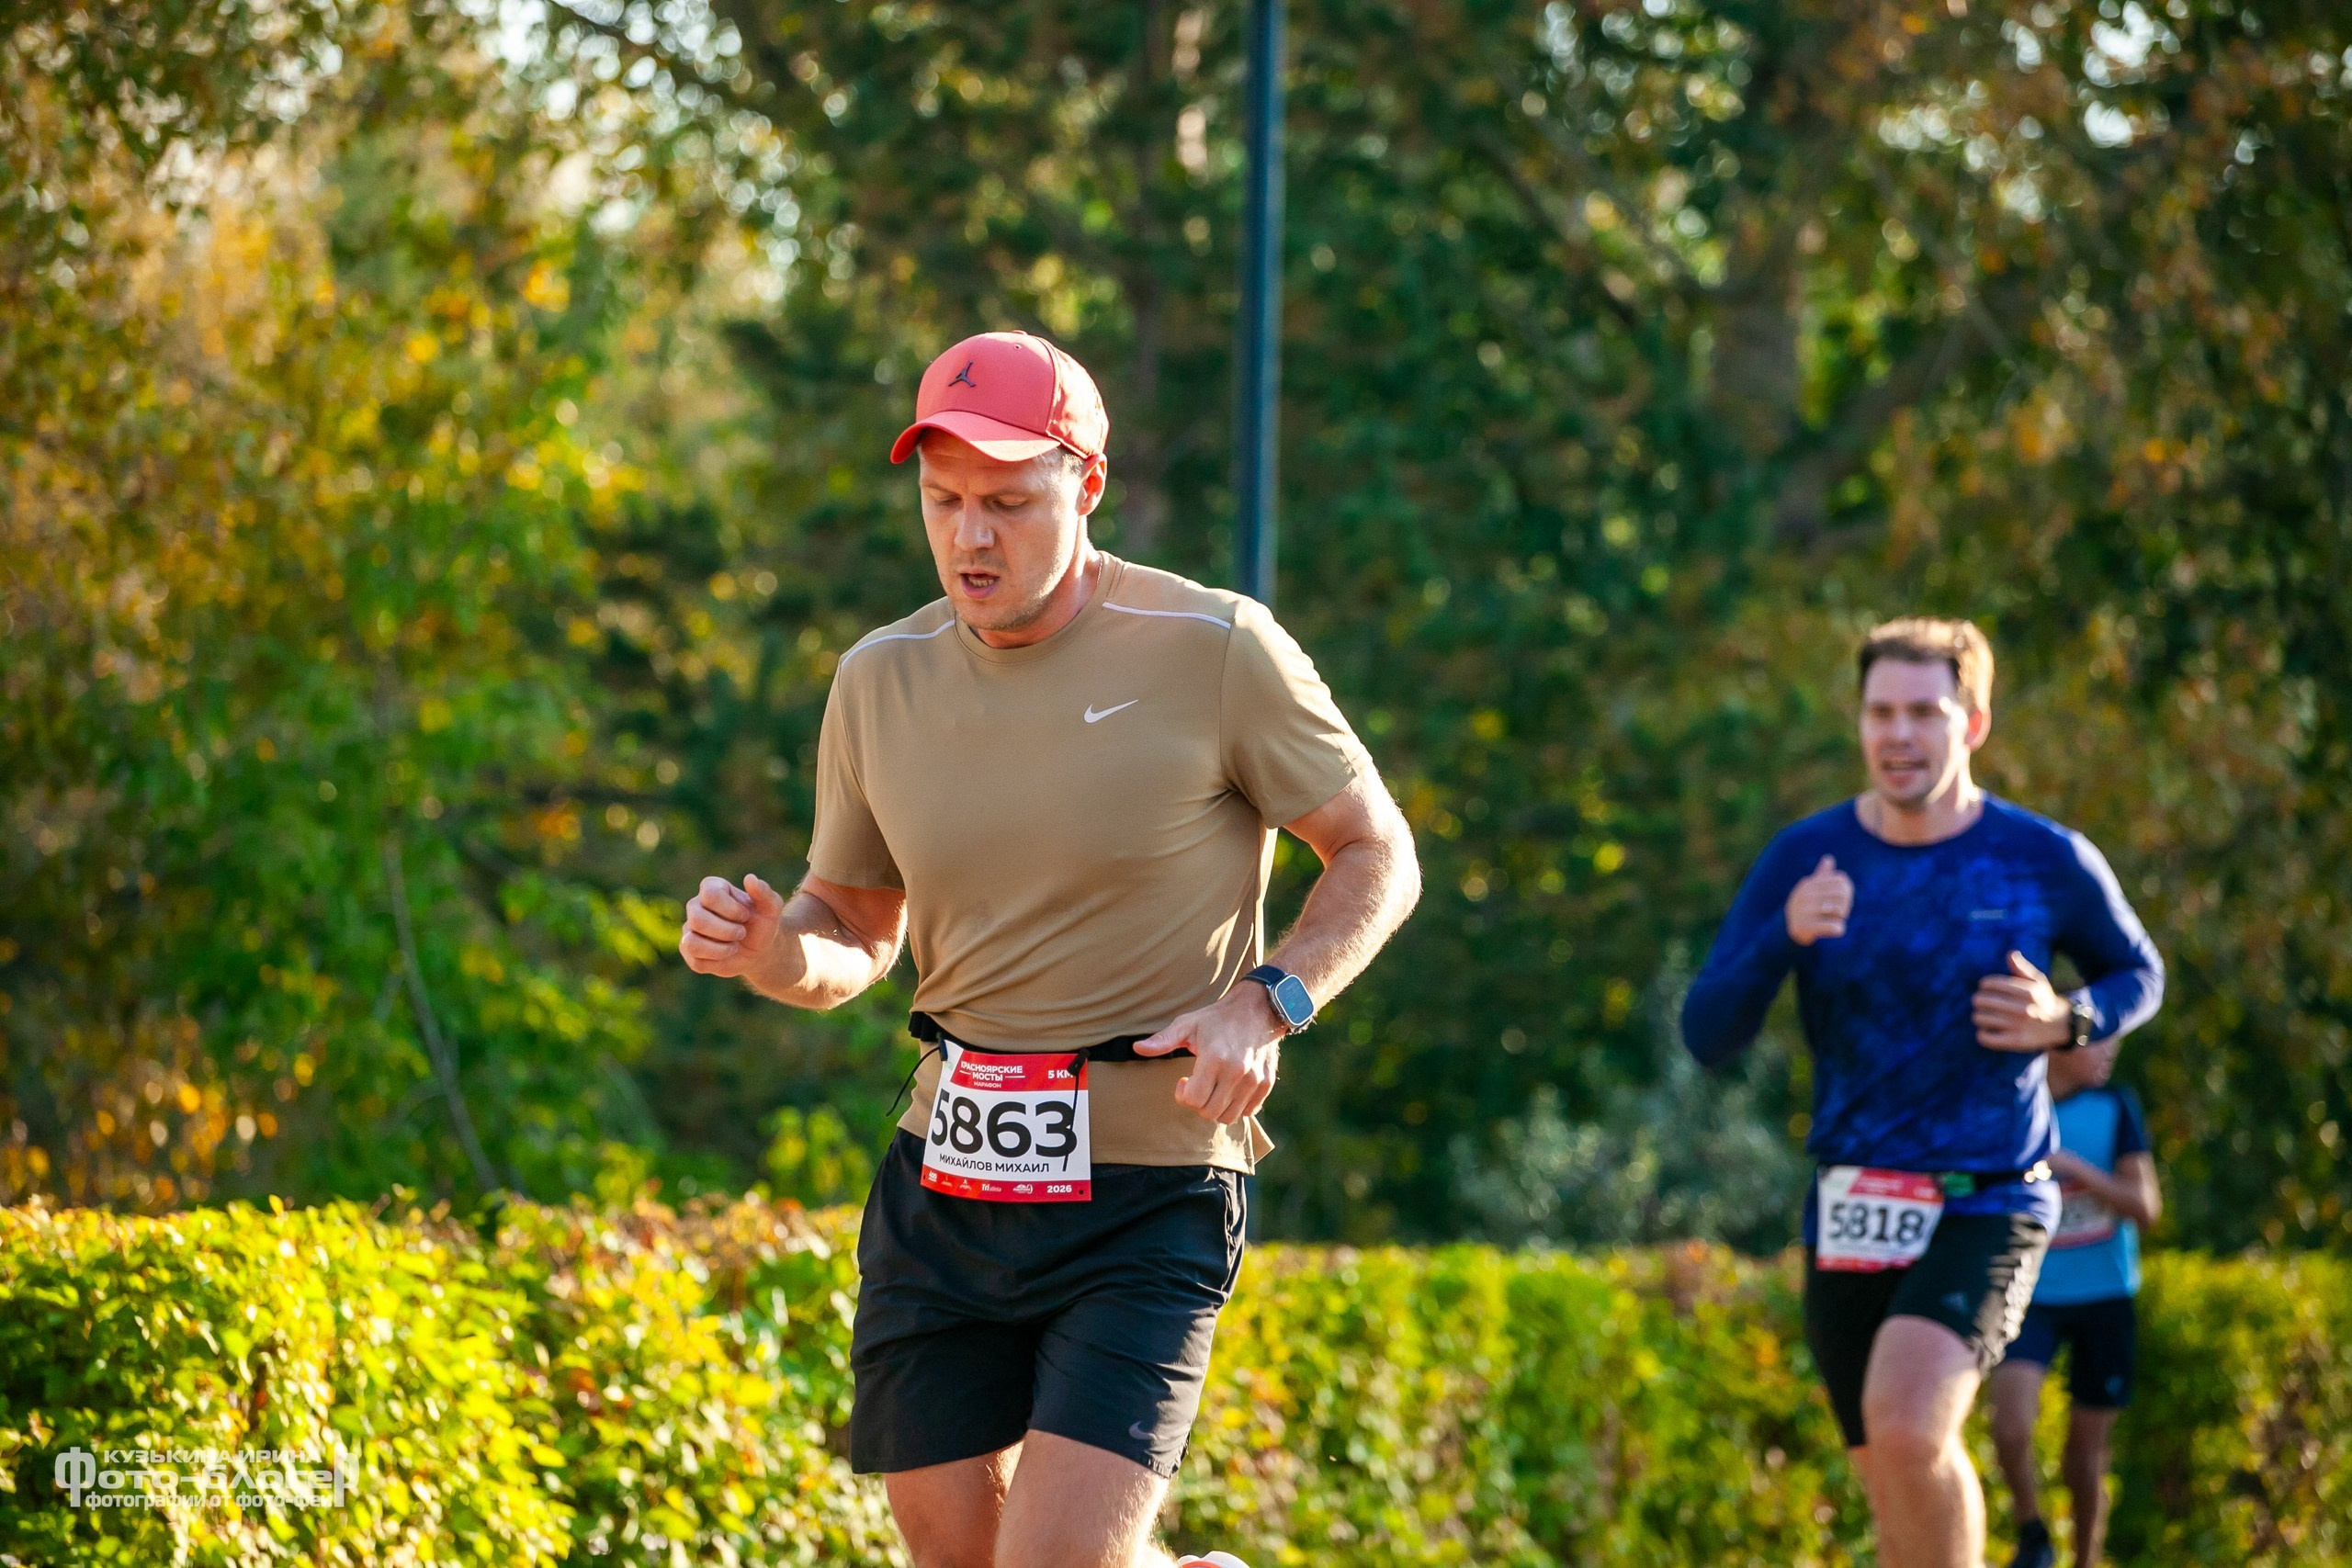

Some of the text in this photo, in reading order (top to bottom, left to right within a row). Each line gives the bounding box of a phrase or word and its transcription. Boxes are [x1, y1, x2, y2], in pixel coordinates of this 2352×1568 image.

[960, 1061, 1023, 1074] КРАСНОЯРСКИЕ
[1047, 1070, 1055, 1078] 5
[972, 1072, 1003, 1082] МОСТЫ
[931, 1089, 1078, 1157] 5863
[939, 1153, 1049, 1172] МИХАЙЛОВ МИХАИЛ
[1046, 1185, 1072, 1193] 2026
[1828, 1202, 1924, 1249] 5818
